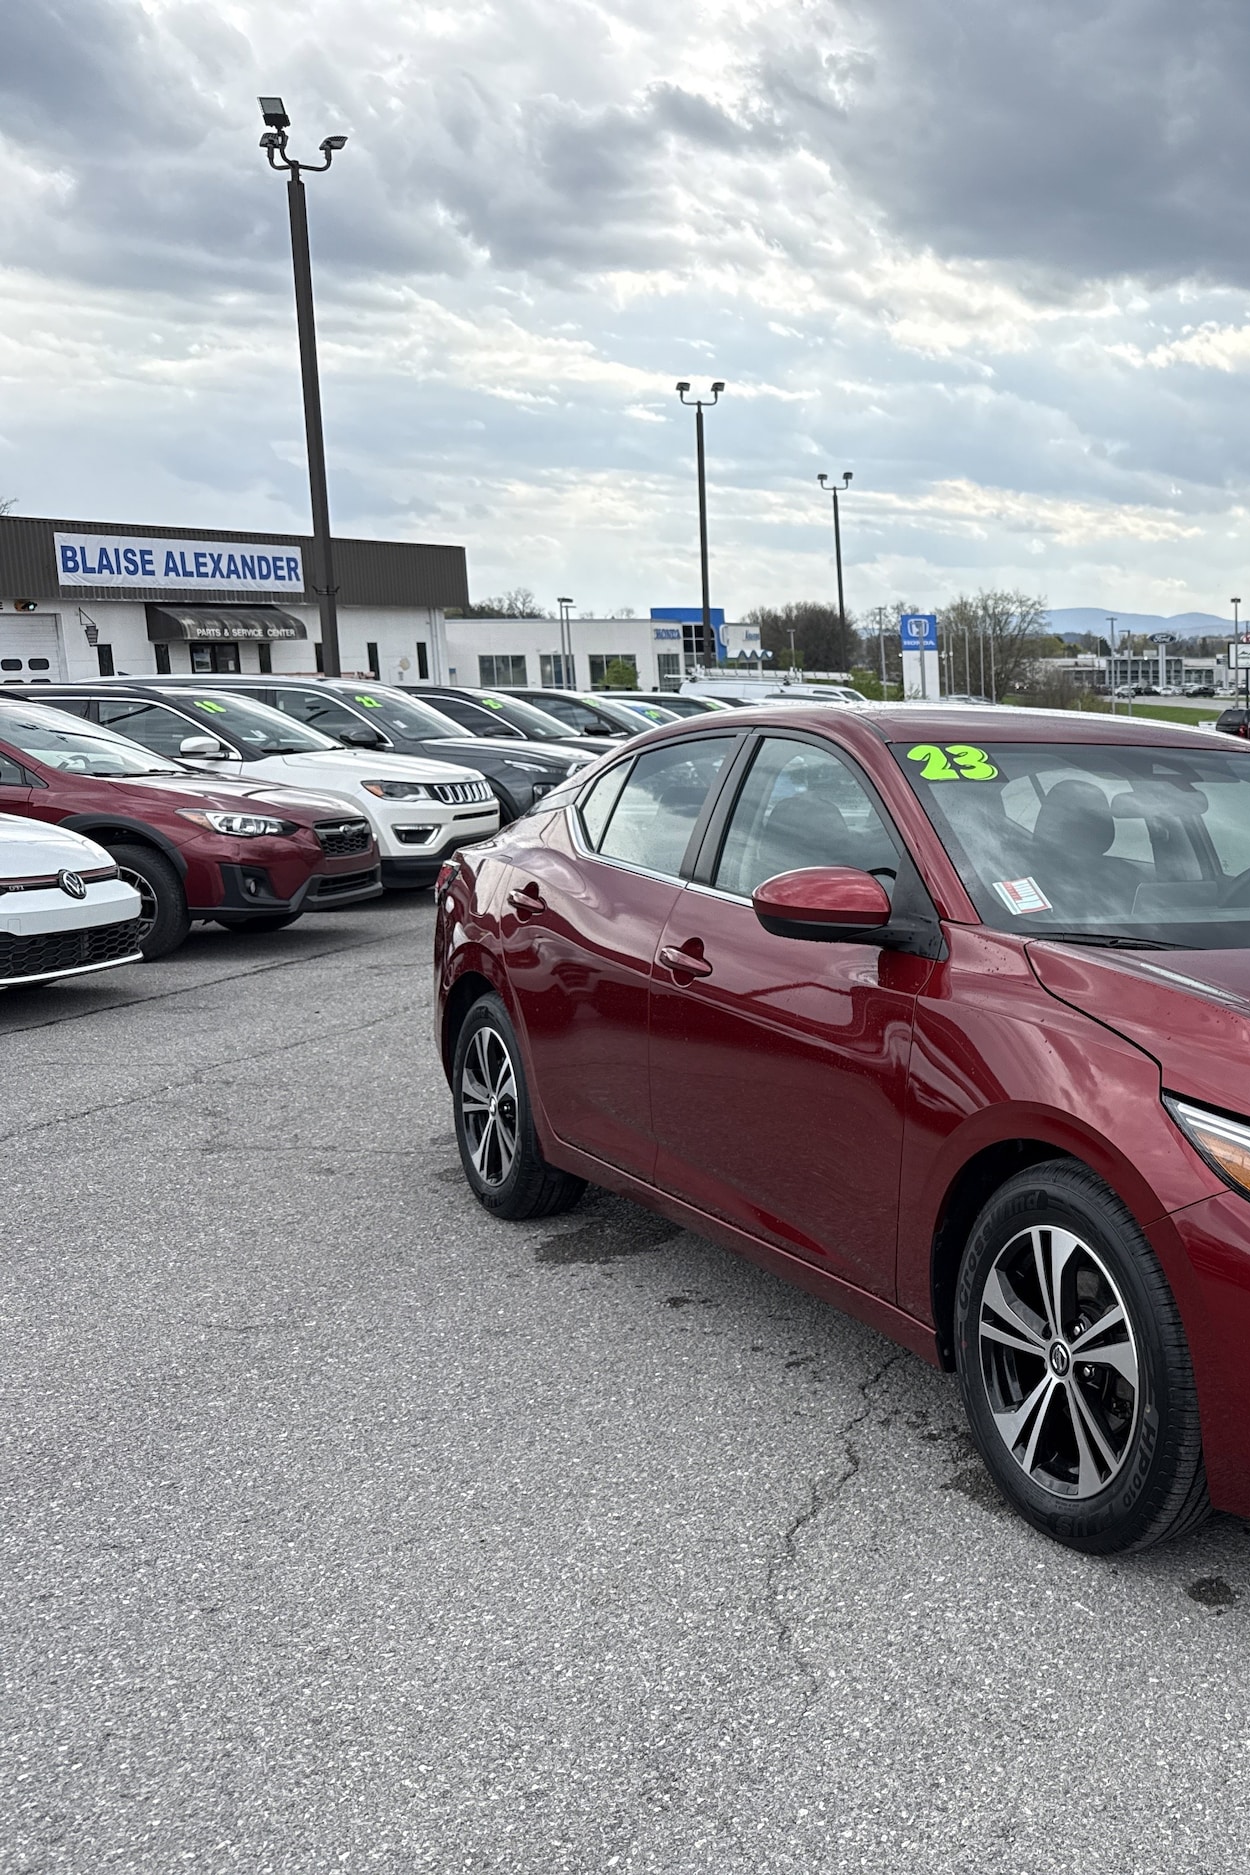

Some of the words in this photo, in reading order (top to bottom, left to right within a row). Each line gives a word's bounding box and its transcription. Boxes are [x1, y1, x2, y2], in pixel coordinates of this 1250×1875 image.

[60, 545, 156, 576] BLAISE
[163, 550, 301, 582] ALEXANDER
[196, 628, 222, 637] PARTS
[224, 628, 230, 637] &
[231, 628, 264, 637] SERVICE
[267, 628, 296, 637] CENTER
[907, 744, 999, 781] 23
